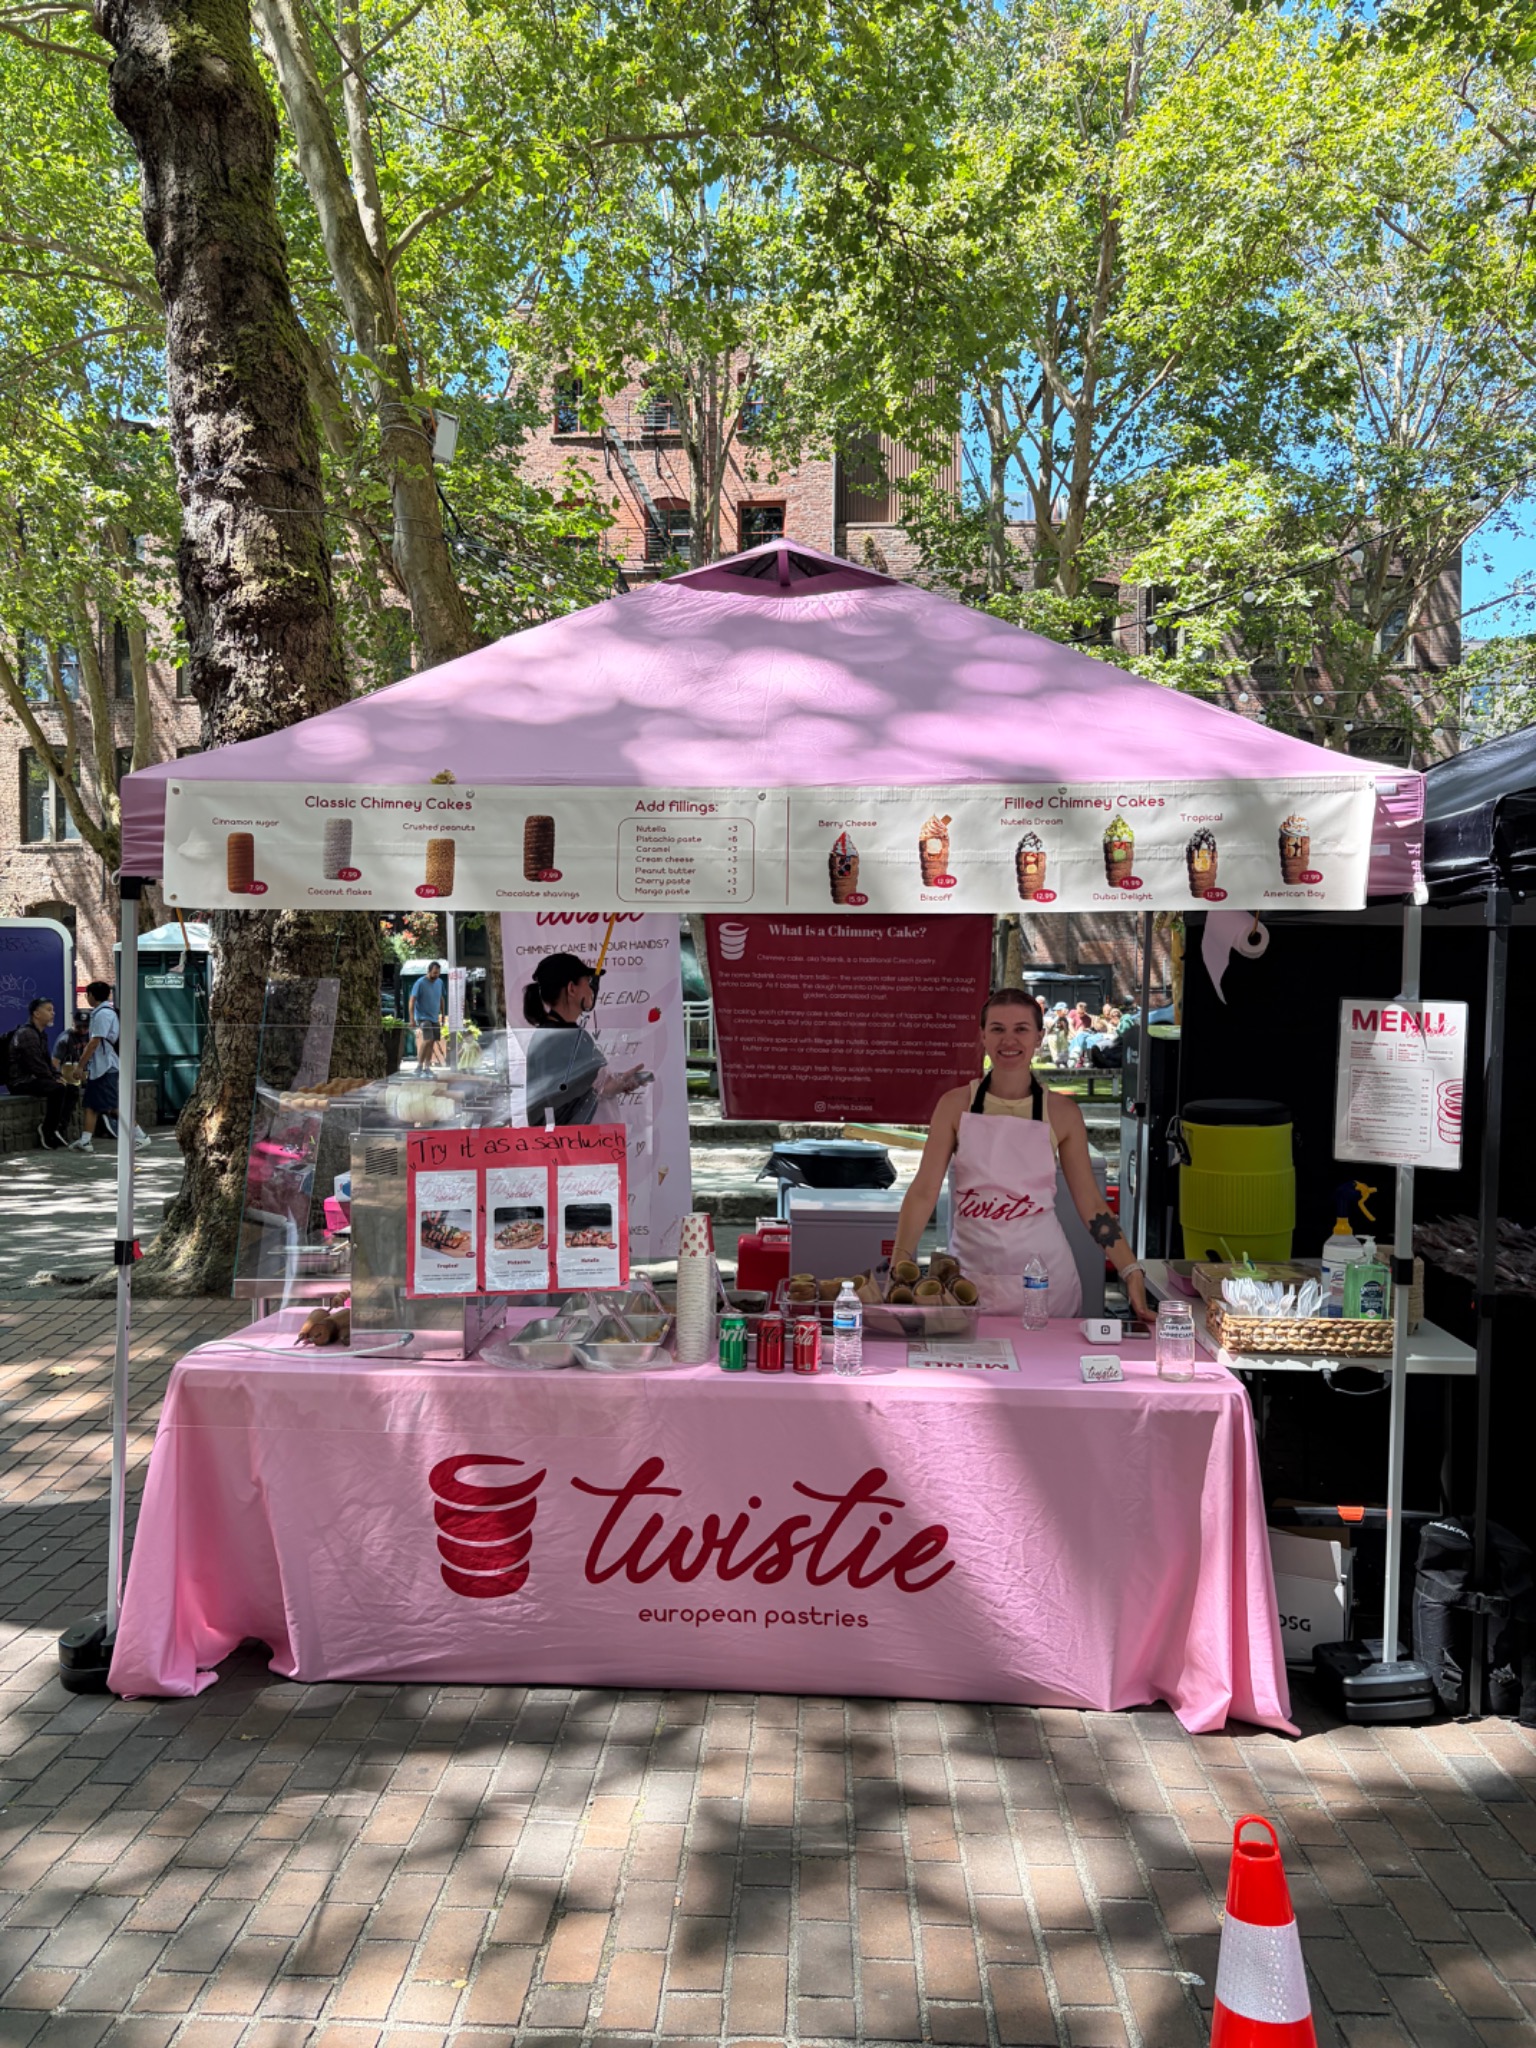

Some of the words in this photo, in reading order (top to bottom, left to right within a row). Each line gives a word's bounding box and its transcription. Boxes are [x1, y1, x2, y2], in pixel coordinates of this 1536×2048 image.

[305, 795, 356, 809] Classic
[360, 797, 422, 812] Chimney
[425, 798, 473, 810] Cakes
[635, 800, 665, 812] Add
[668, 801, 719, 815] fillings:
[1004, 796, 1043, 809] Filled
[1048, 796, 1112, 811] Chimney
[1116, 795, 1165, 807] Cakes
[212, 817, 253, 826] Cinnamon
[255, 819, 279, 828] sugar
[1000, 818, 1032, 826] Nutella
[1034, 818, 1063, 826] Dream
[1180, 813, 1223, 823] Tropical
[402, 823, 439, 831] Crushed
[440, 824, 475, 832] peanuts
[818, 820, 843, 829] Berry
[636, 835, 675, 843] Pistachio
[676, 836, 702, 844] paste
[635, 877, 665, 887] Cherry
[665, 878, 691, 886] paste
[307, 887, 344, 896] Coconut
[345, 887, 372, 896] flakes
[496, 889, 541, 897] Chocolate
[542, 890, 580, 900] shavings
[635, 887, 663, 896] Mango
[665, 888, 690, 896] paste
[920, 893, 953, 901] Biscoff
[1093, 892, 1119, 900] Dubai
[1120, 892, 1153, 902] Delight
[1263, 890, 1305, 898] American
[1307, 890, 1325, 899] Boy
[768, 924, 802, 936] What
[805, 925, 816, 936] is
[817, 927, 826, 937] a
[827, 925, 883, 941] Chimney
[886, 926, 927, 938] Cake?
[516, 945, 558, 956] CHIMNEY
[560, 943, 586, 954] CAKE
[587, 942, 597, 952] IN
[629, 938, 669, 951] HANDS?
[612, 956, 626, 966] TO
[598, 991, 616, 1005] HE
[616, 989, 650, 1005] END
[1351, 1009, 1446, 1034] MENU
[411, 1136, 447, 1166] Try
[459, 1135, 476, 1158] it
[484, 1138, 511, 1155] as
[515, 1136, 529, 1152] a
[534, 1130, 627, 1151] sandwich
[955, 1188, 1044, 1222] twisti
[570, 1456, 957, 1594] twistie
[637, 1605, 757, 1629] european
[764, 1605, 870, 1630] pastries
